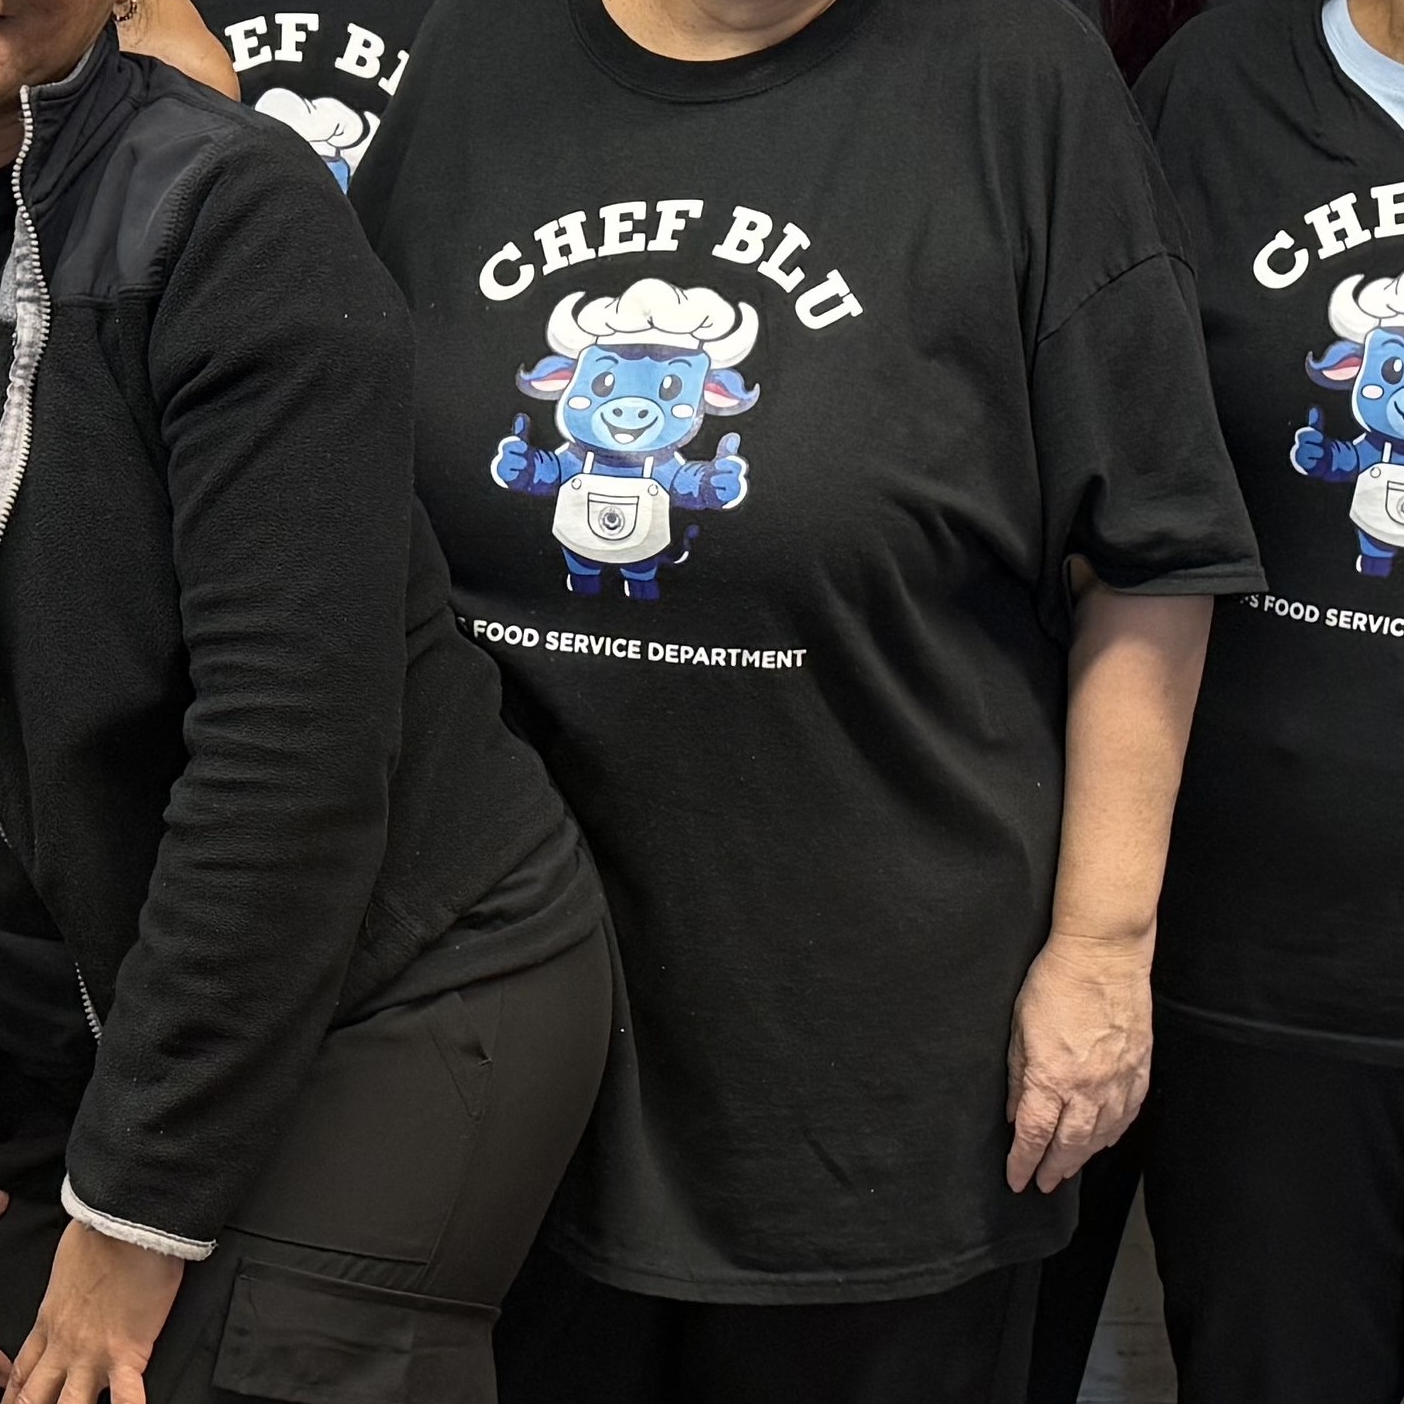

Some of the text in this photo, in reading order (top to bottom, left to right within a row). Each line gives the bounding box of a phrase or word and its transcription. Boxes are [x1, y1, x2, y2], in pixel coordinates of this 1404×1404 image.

[478, 198, 865, 331] CHEF BLU
[1263, 594, 1321, 624] FOOD
[472, 618, 808, 670] FOOD SERVICE DEPARTMENT
